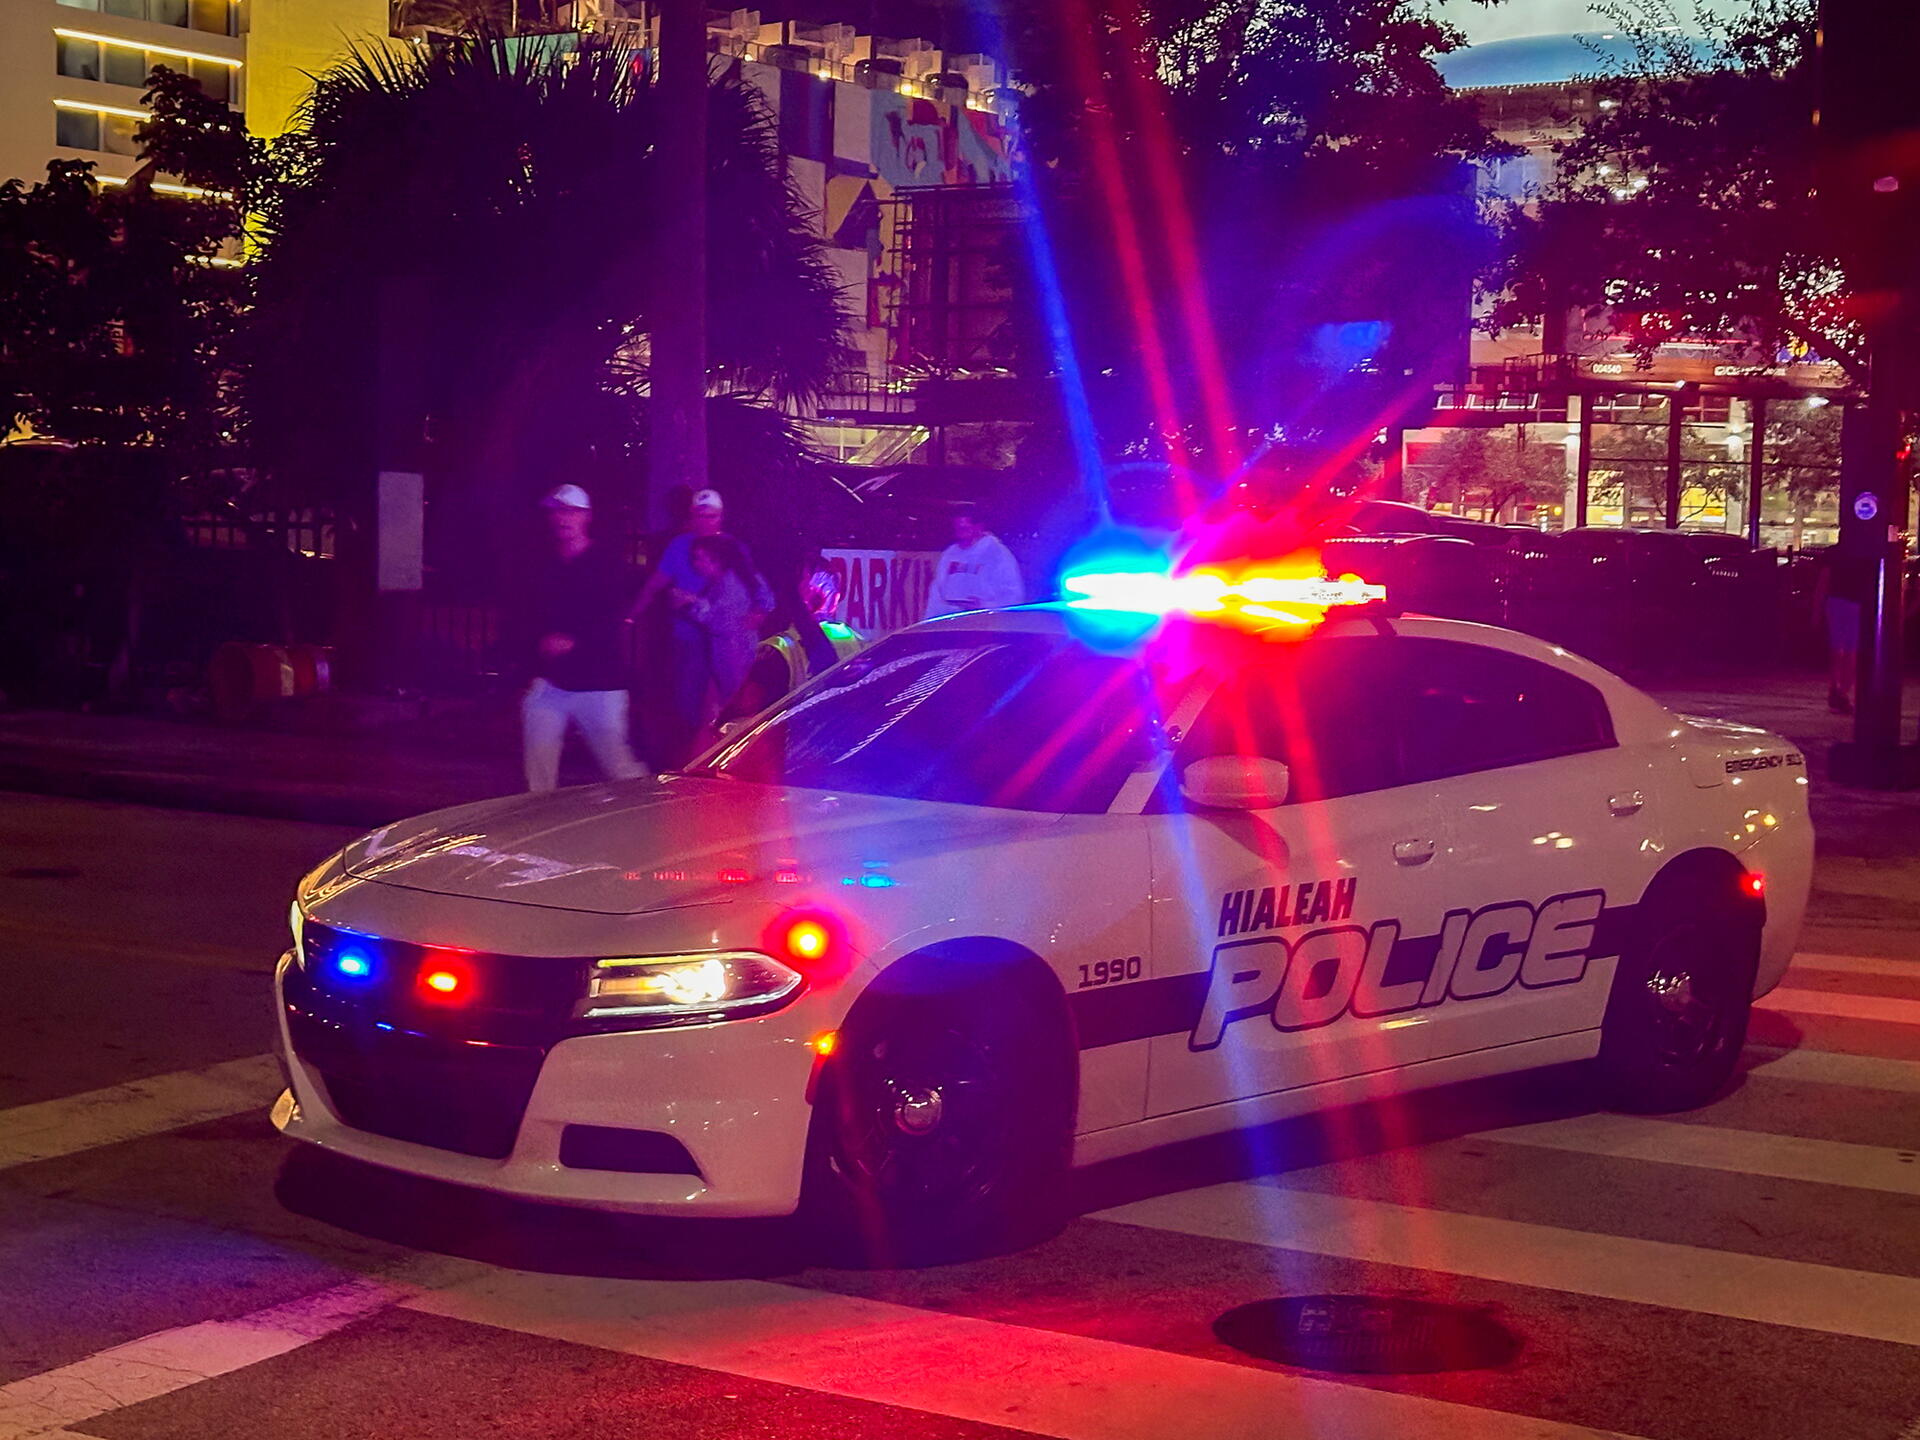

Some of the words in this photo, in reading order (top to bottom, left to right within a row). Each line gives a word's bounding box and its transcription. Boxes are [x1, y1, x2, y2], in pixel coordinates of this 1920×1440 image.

[1725, 755, 1783, 774] EMERGENCY
[1218, 877, 1357, 937] HIALEAH
[1078, 956, 1141, 989] 1990
[1188, 888, 1606, 1051] POLICE
